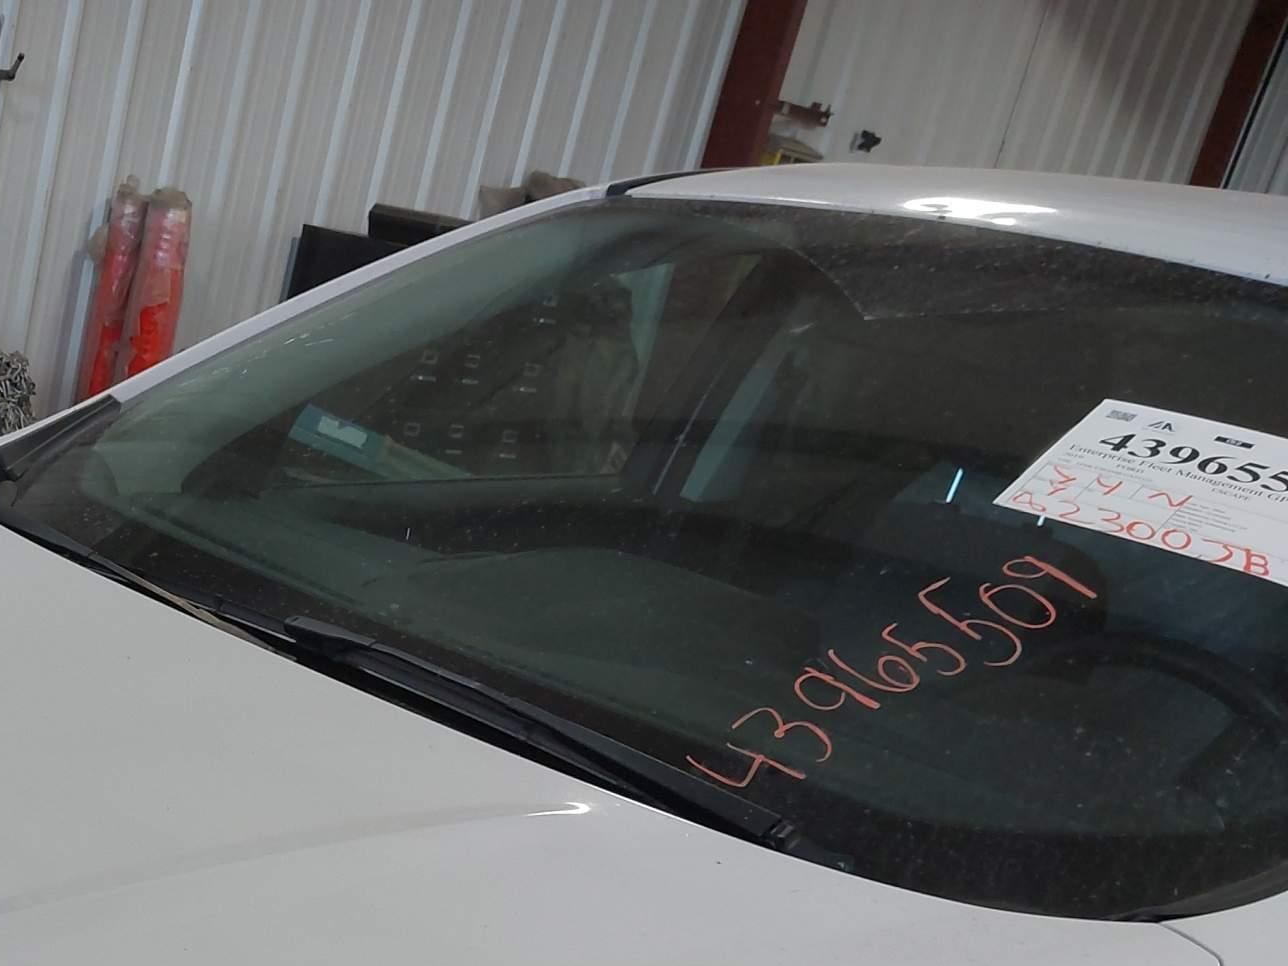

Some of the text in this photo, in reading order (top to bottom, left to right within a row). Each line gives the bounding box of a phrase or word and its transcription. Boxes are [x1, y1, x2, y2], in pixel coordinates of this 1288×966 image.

[1069, 443, 1137, 464] Enterprise
[1138, 460, 1173, 474] Fleet
[1174, 468, 1264, 497] Management
[685, 555, 1098, 788] 43965509
